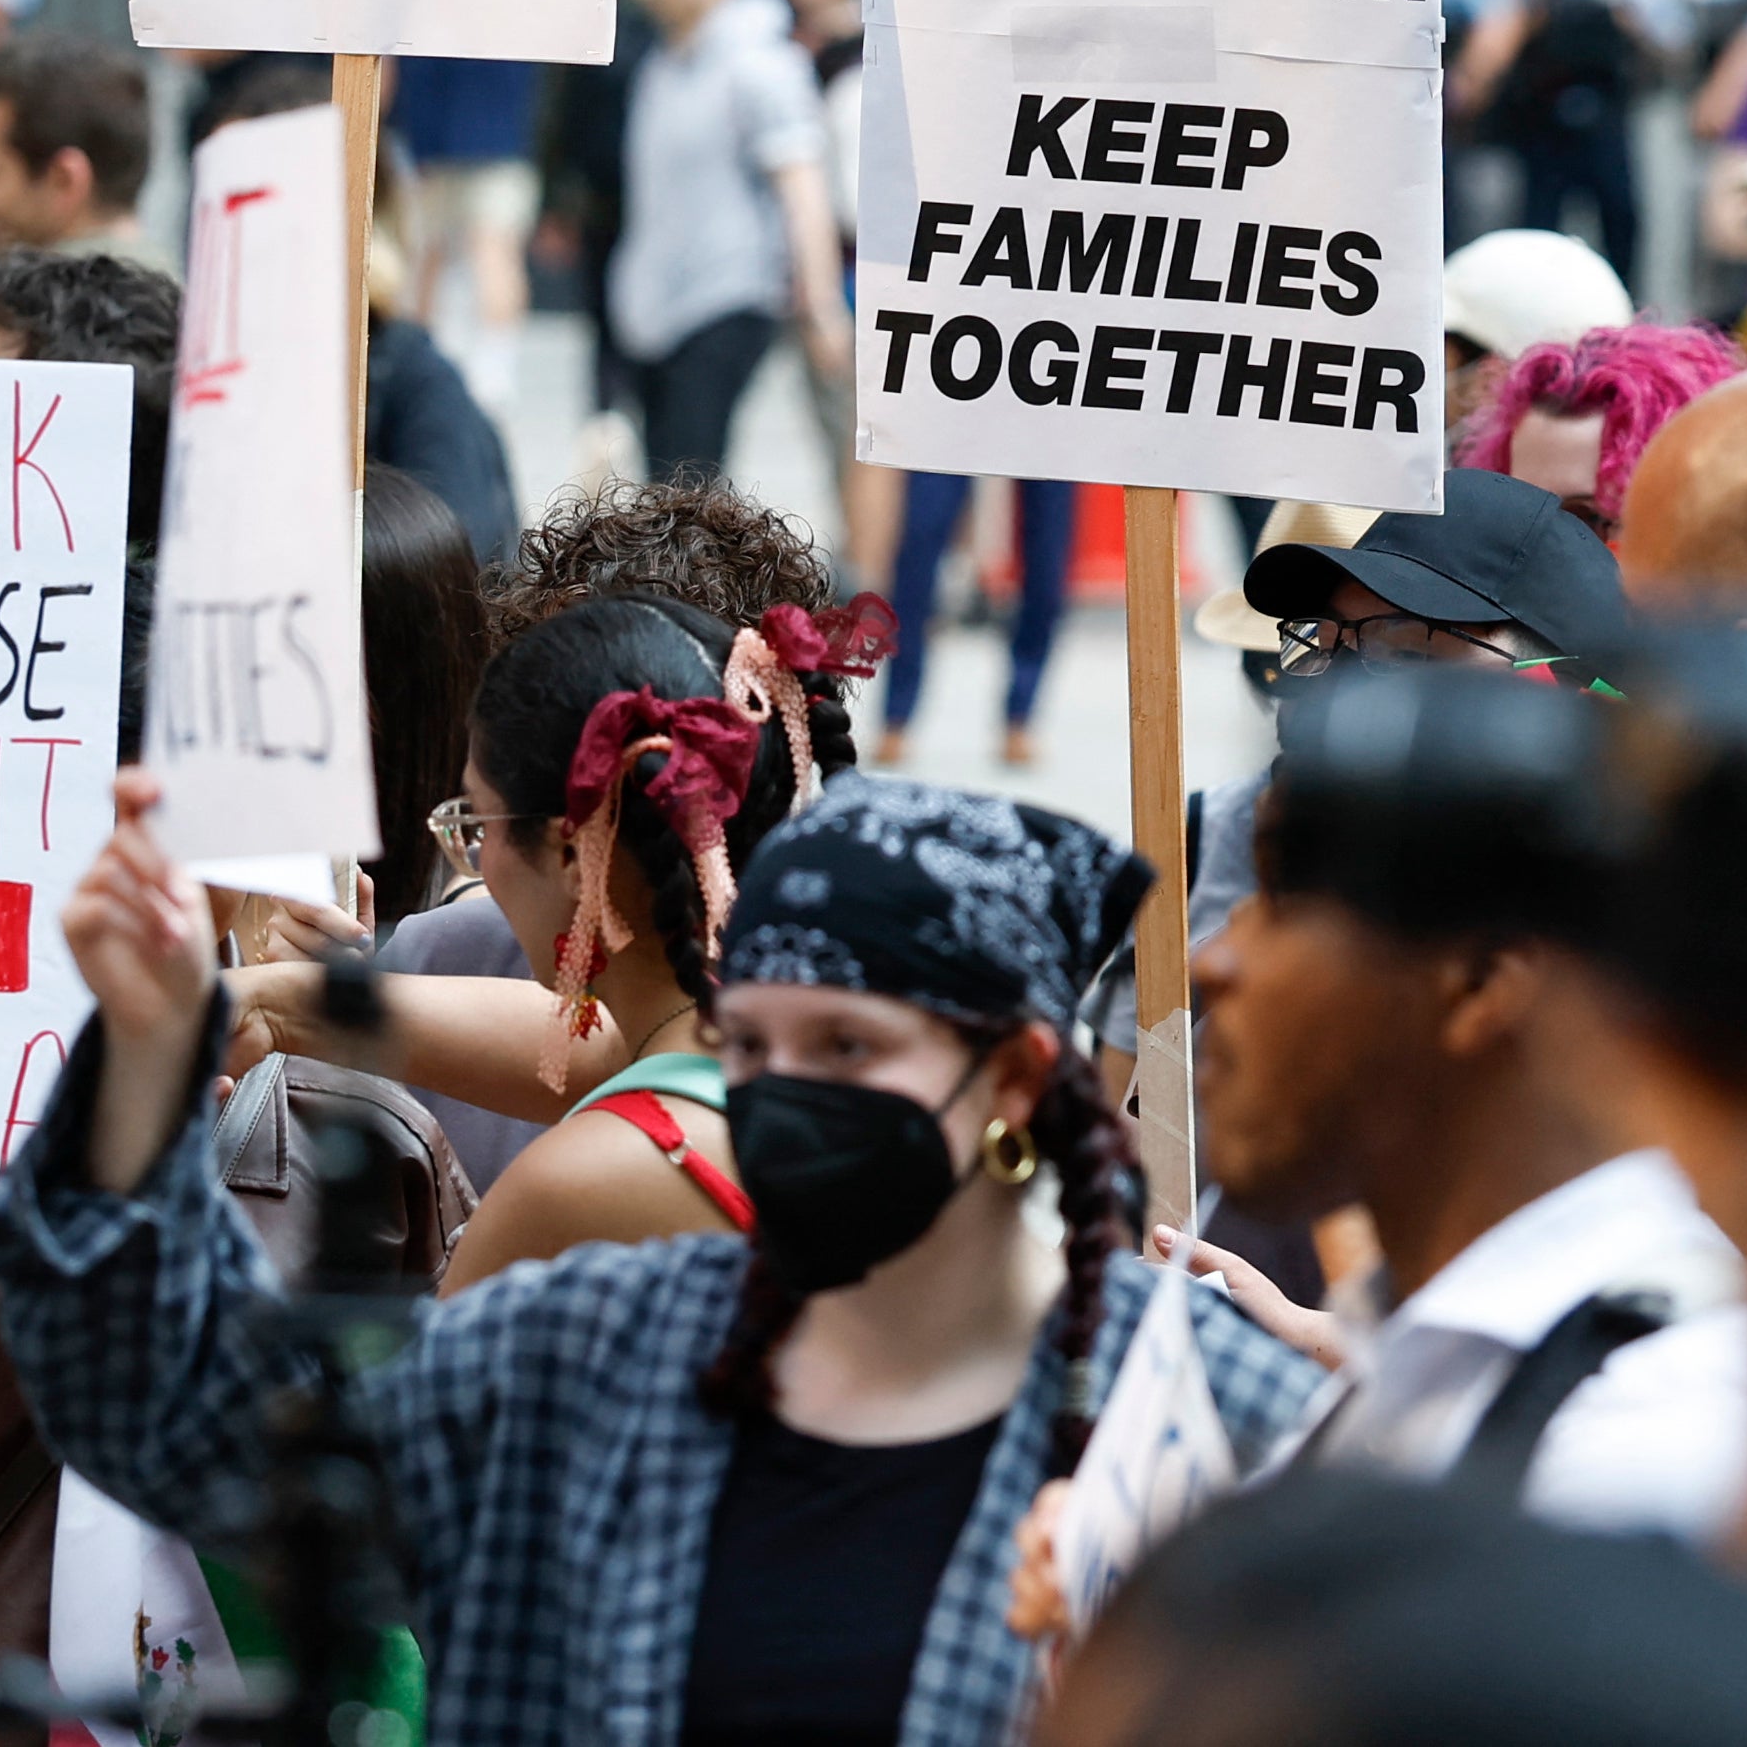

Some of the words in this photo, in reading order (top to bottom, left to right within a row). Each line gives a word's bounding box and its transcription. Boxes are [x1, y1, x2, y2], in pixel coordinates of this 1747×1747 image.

[1004, 93, 1290, 192] KEEP
[906, 200, 1383, 318] FAMILIES
[874, 308, 1427, 435] TOGETHER
